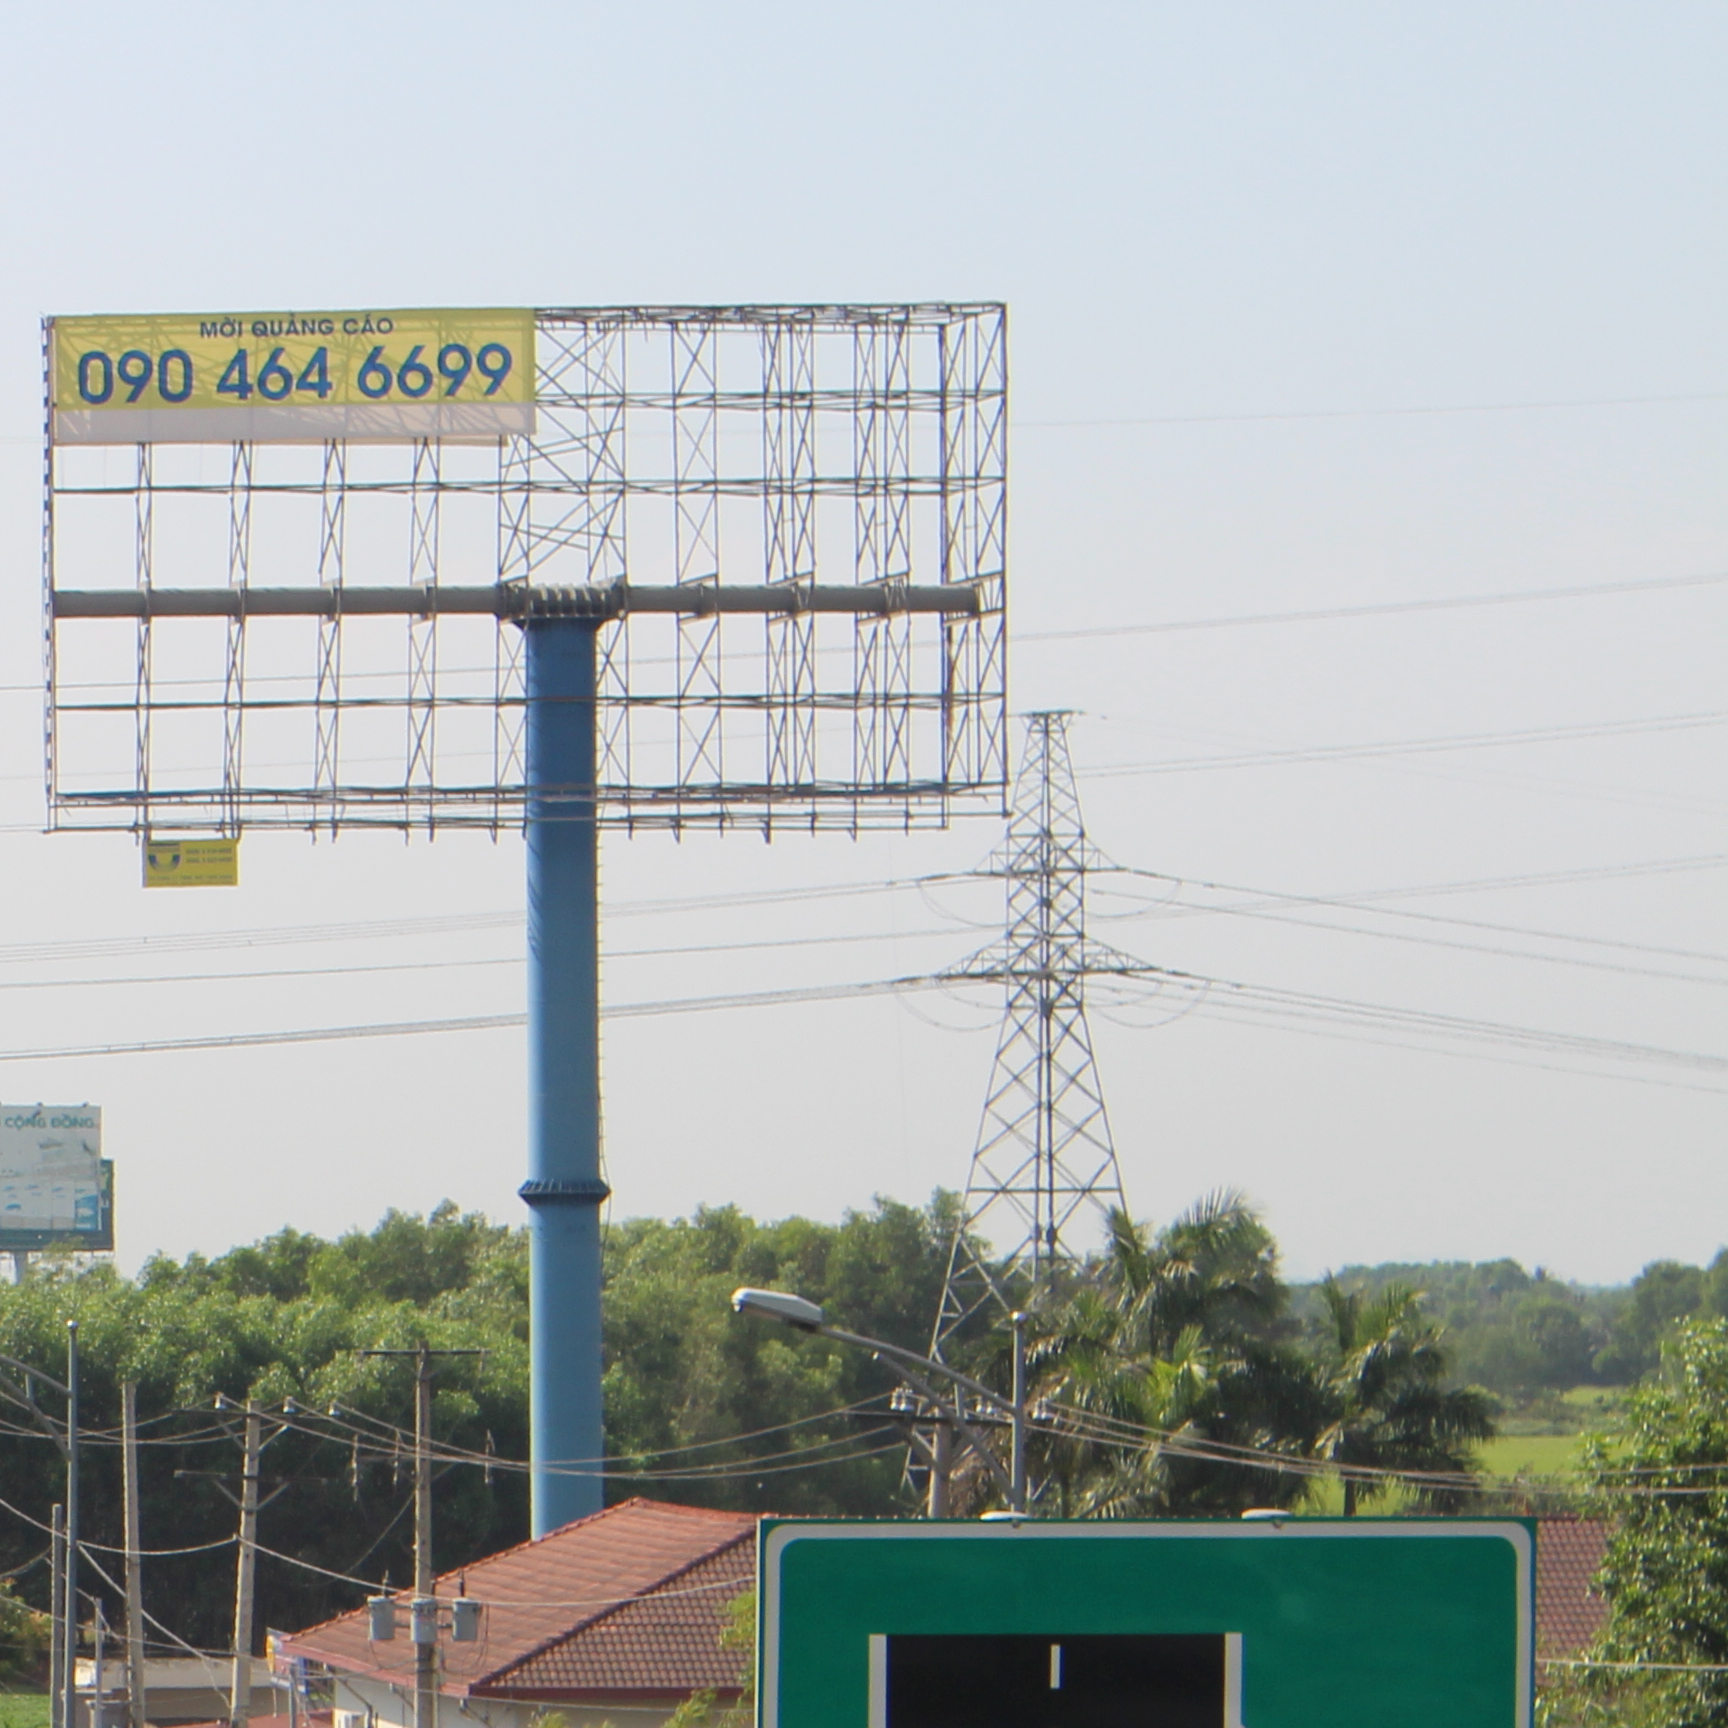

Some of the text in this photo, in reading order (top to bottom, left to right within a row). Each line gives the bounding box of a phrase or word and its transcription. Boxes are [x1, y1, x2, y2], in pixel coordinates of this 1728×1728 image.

[200, 312, 394, 338] MỜI QUẢNG CÁO
[78, 343, 513, 405] 090 464 6699
